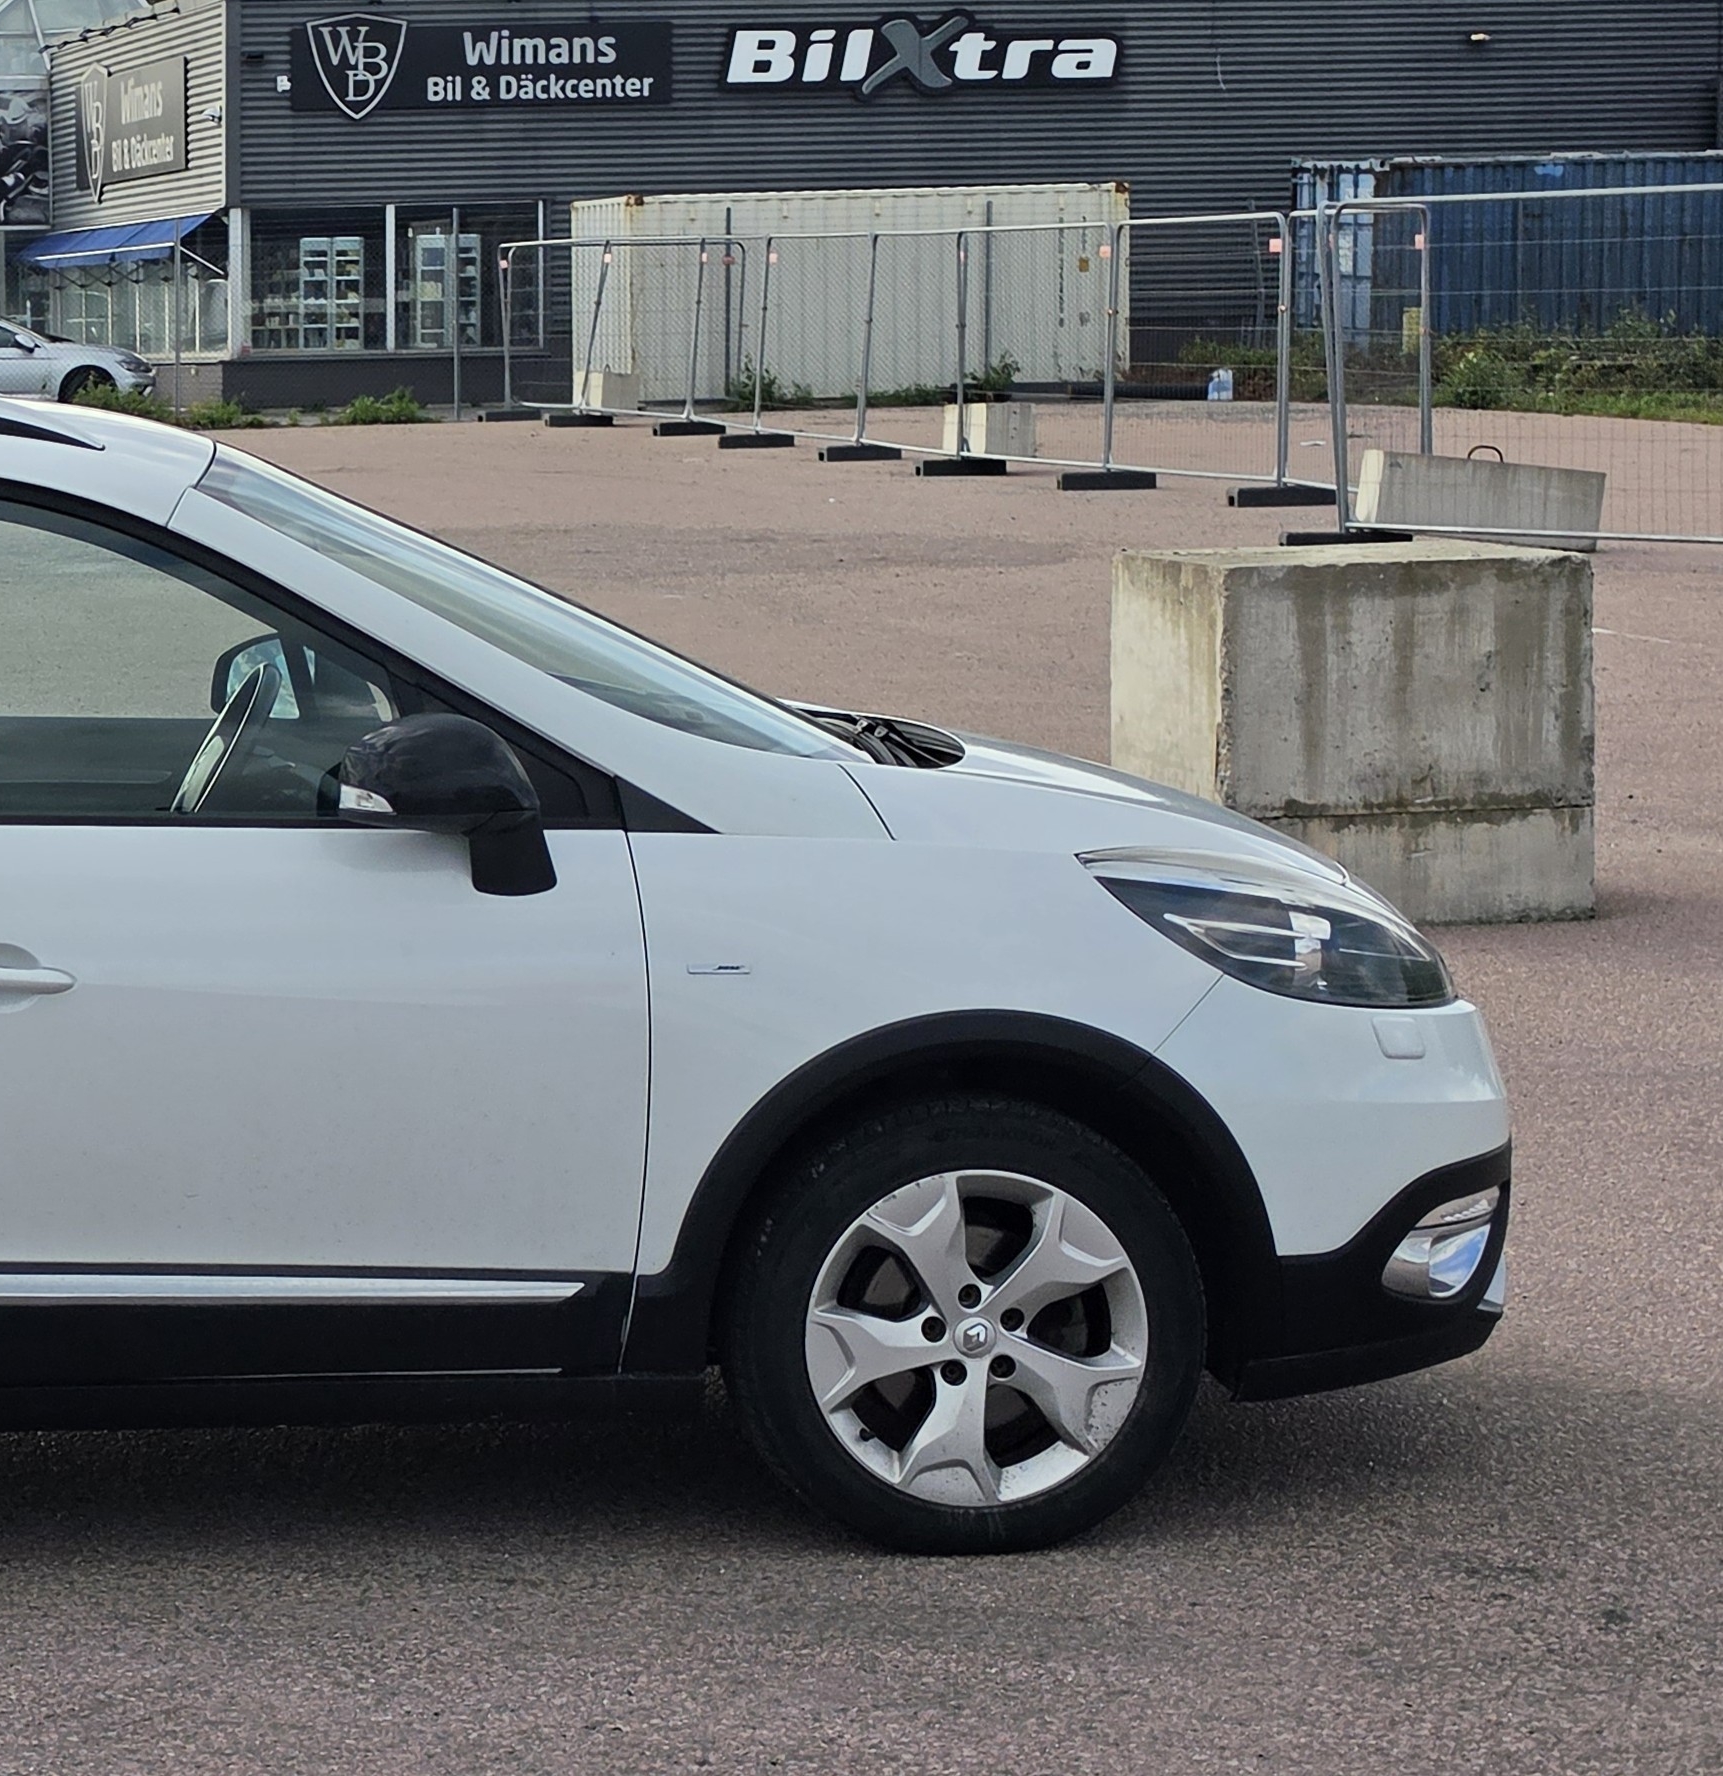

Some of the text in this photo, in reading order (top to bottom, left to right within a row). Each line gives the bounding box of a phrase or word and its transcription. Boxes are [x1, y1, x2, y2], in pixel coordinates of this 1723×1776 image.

[462, 30, 617, 66] Wimans
[726, 15, 1118, 95] BilXtra
[120, 77, 163, 125] Wimans
[427, 73, 654, 102] Bil & Däckcenter
